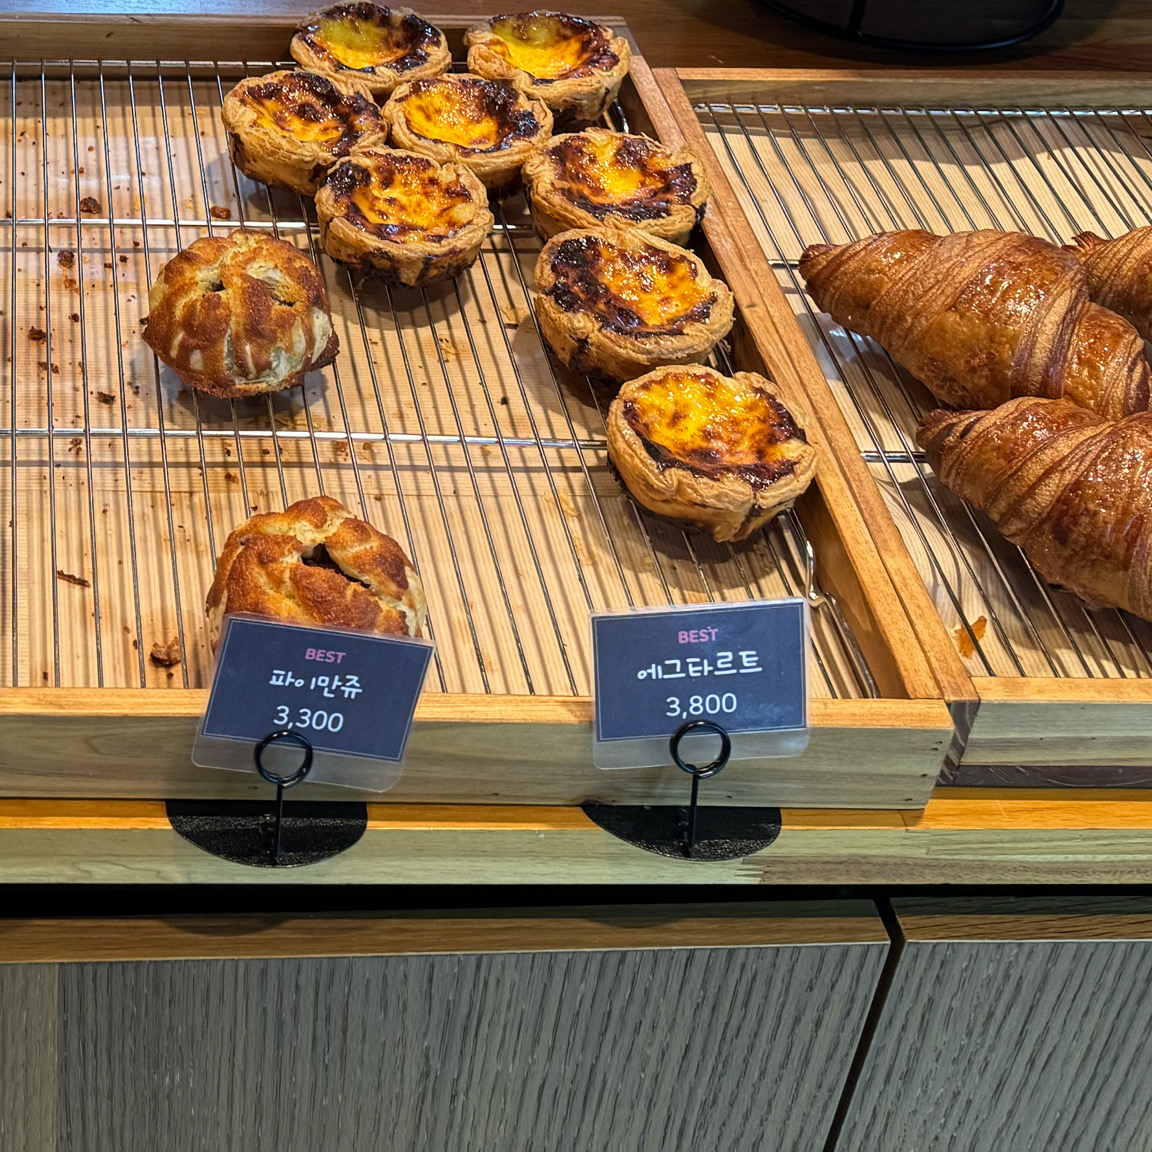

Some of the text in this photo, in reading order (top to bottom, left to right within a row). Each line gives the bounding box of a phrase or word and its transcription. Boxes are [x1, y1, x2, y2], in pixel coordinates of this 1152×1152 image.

[678, 628, 719, 644] BEST
[304, 647, 346, 664] BEST
[637, 650, 763, 680] 에그타르트
[269, 669, 363, 699] 파이만쥬
[273, 705, 345, 733] 3,300
[666, 692, 738, 719] 3,800
